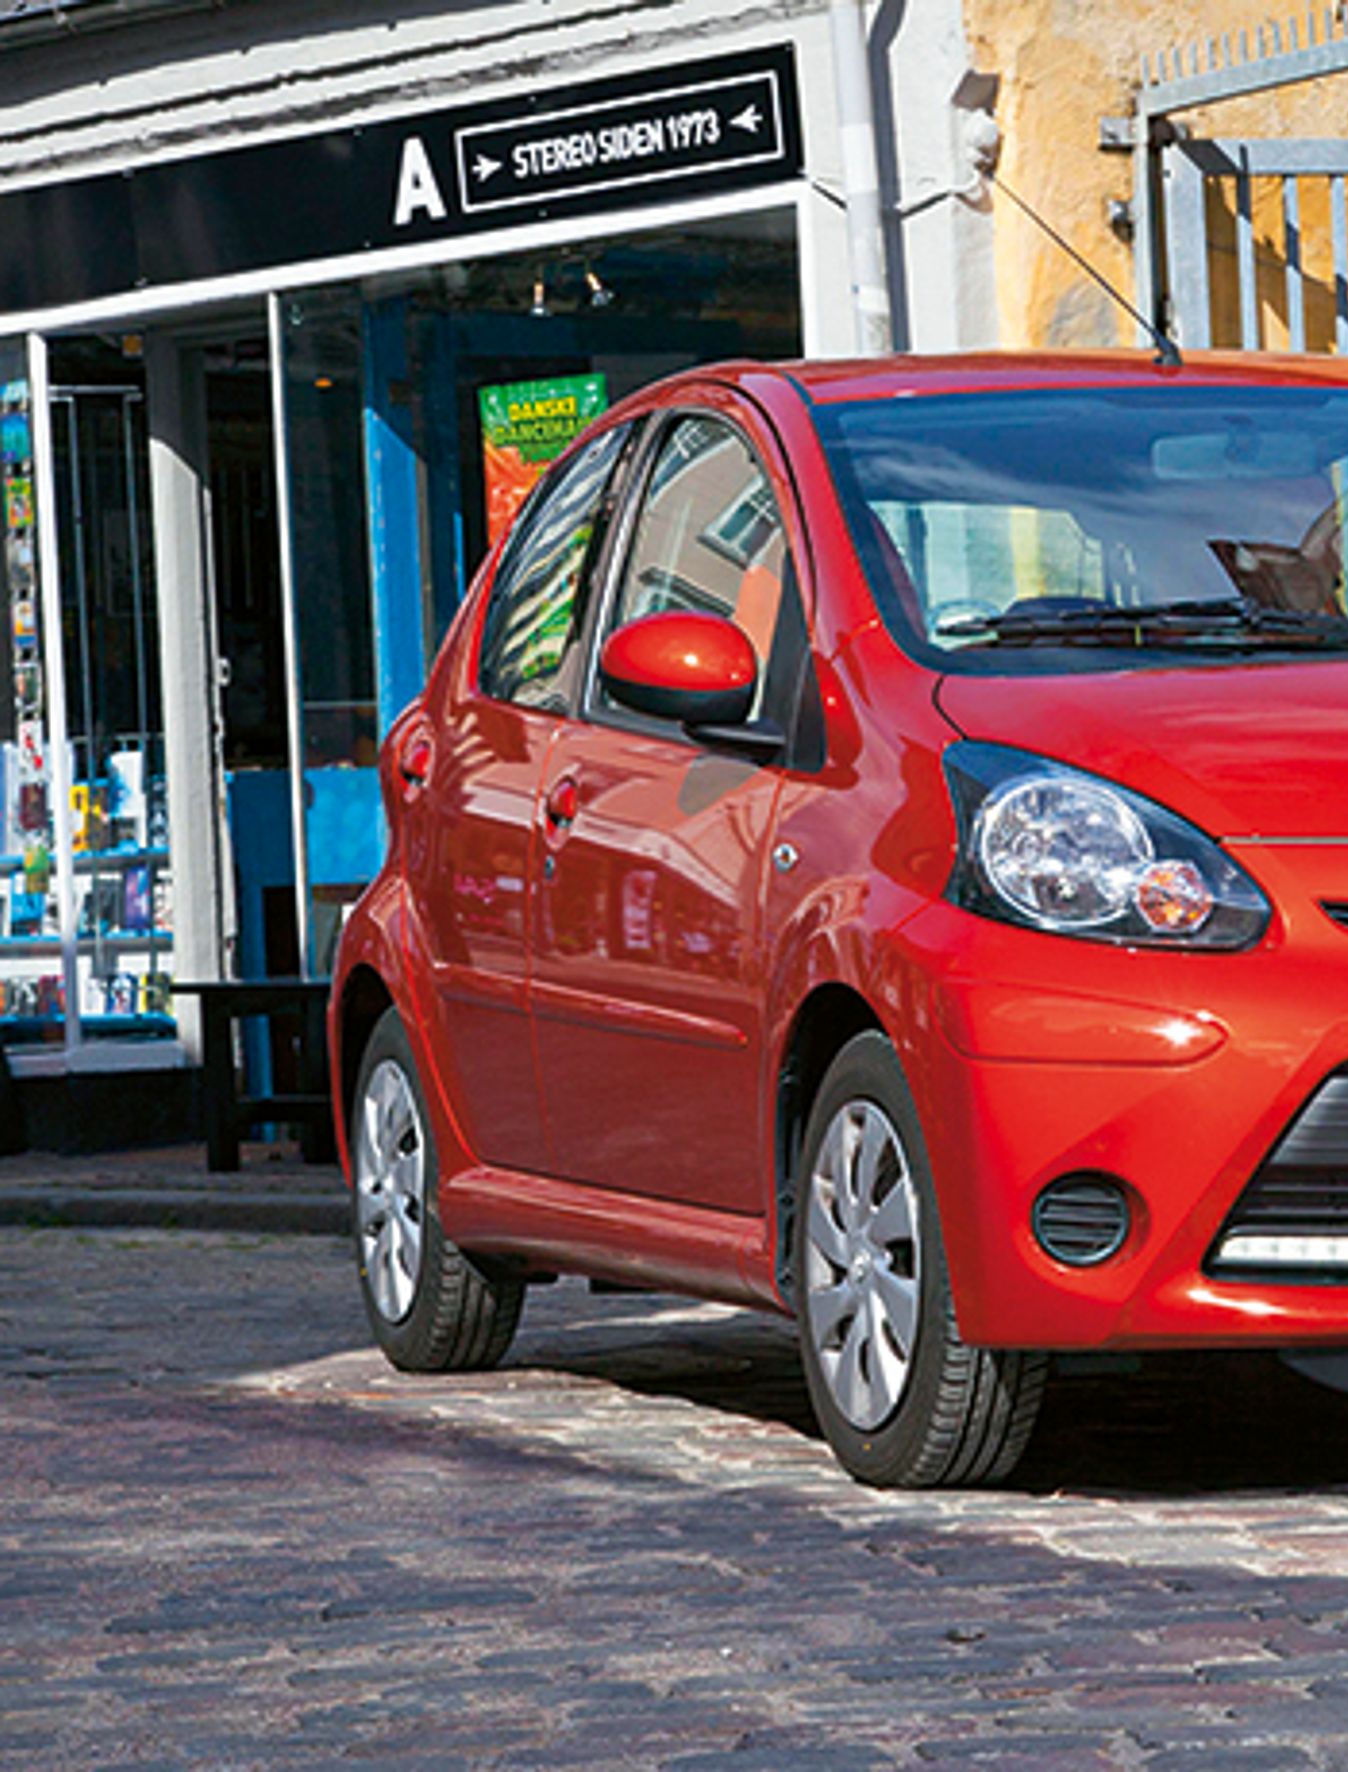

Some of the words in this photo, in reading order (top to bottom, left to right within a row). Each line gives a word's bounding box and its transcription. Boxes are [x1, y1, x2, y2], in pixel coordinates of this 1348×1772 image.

[394, 137, 447, 225] A
[512, 132, 597, 178] STEREO
[598, 119, 664, 162] SIDEN
[666, 108, 721, 150] 1973
